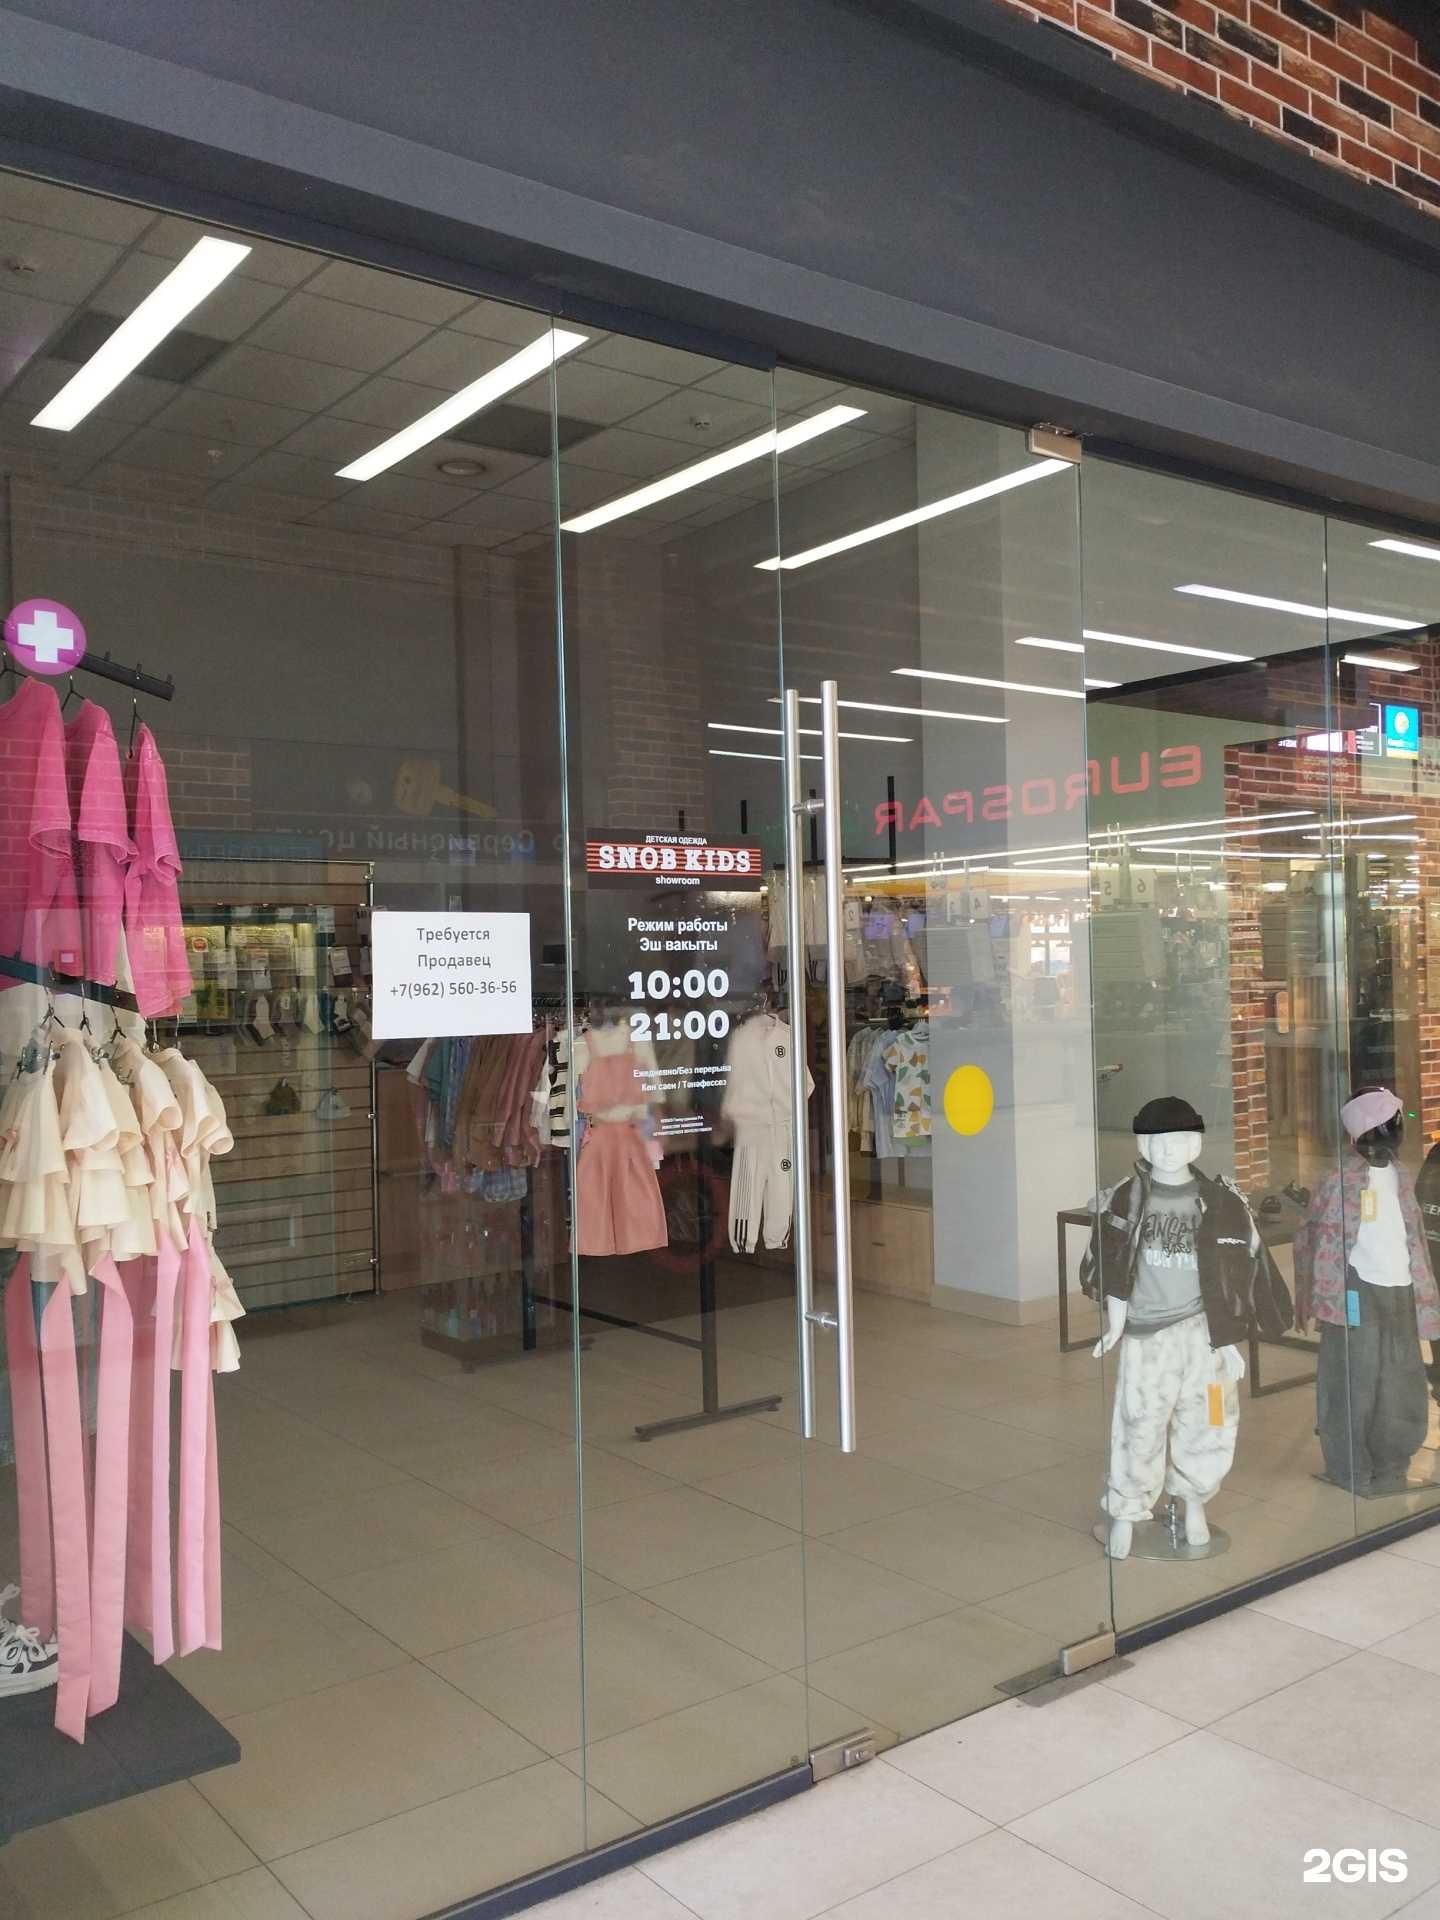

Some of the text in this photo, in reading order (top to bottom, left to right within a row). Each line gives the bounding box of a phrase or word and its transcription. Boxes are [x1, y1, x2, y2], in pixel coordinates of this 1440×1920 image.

[645, 835, 708, 846] ДЕТСКАЯ ОДЕЖДА
[599, 845, 751, 873] SNOB KIDS
[655, 875, 700, 885] showroom
[416, 926, 491, 943] Требуется
[627, 917, 728, 935] Режим работы
[639, 937, 718, 951] Эш вакыты
[417, 954, 492, 970] Продавец
[390, 980, 518, 1000] +7(962) 560-36-56
[628, 968, 730, 1000] 10:00
[629, 1009, 730, 1042] 21:00
